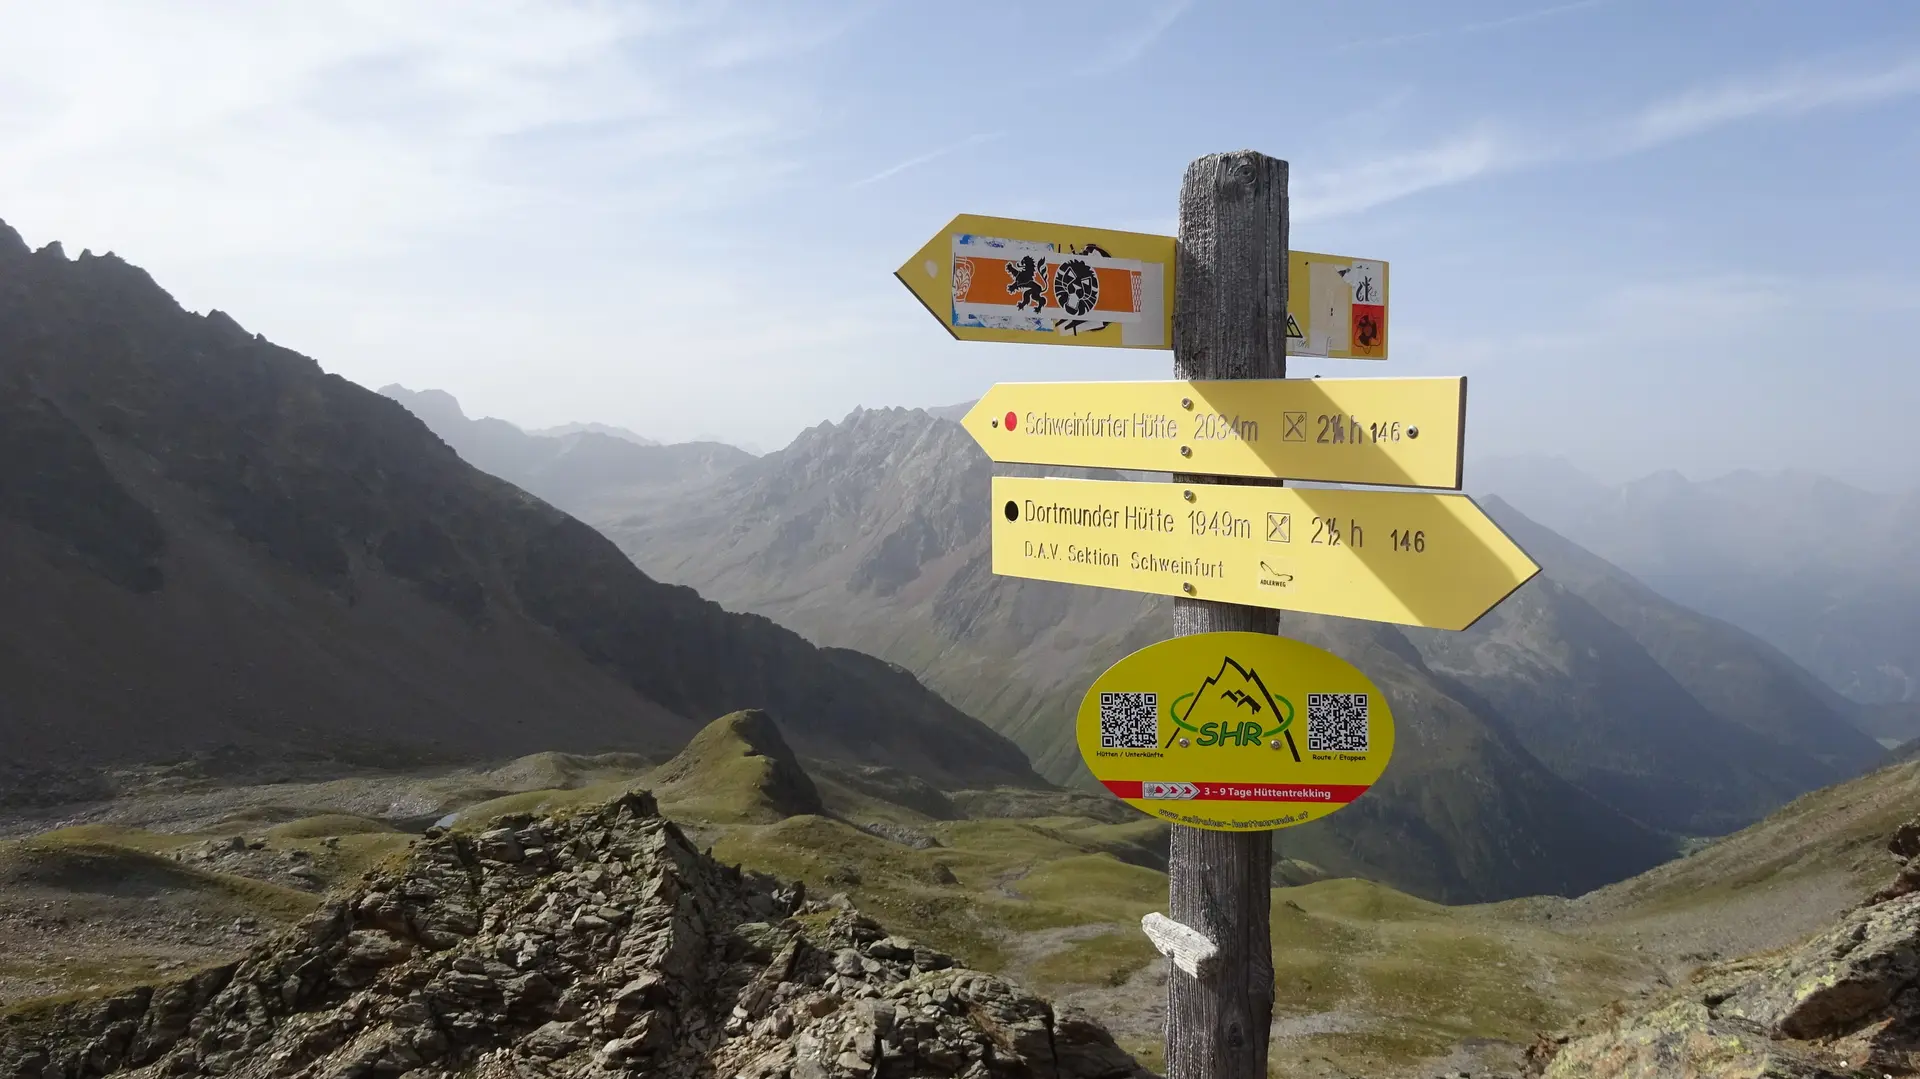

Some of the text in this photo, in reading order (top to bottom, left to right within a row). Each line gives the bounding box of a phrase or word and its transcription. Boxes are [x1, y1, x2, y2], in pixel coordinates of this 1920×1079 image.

[1025, 411, 1129, 438] Schweinfurter
[1132, 412, 1178, 440] Hütte
[1193, 413, 1259, 442] 2034m
[1349, 414, 1363, 444] h
[1370, 421, 1401, 444] 146
[1024, 500, 1120, 528] Dortmunder
[1125, 505, 1175, 533] Hütte
[1187, 510, 1252, 539] 1949m
[1350, 518, 1363, 548] h
[1390, 529, 1425, 553] 146
[1024, 540, 1225, 579] D.A.V. Sektion Schweinfurt
[1260, 579, 1287, 588] ADLERWEG
[1196, 721, 1263, 748] SHR
[1339, 754, 1366, 762] Etappen
[1204, 787, 1210, 797] 3
[1220, 787, 1226, 797] 9
[1228, 787, 1252, 799] Tage
[1254, 788, 1331, 800] Hüttentrekking
